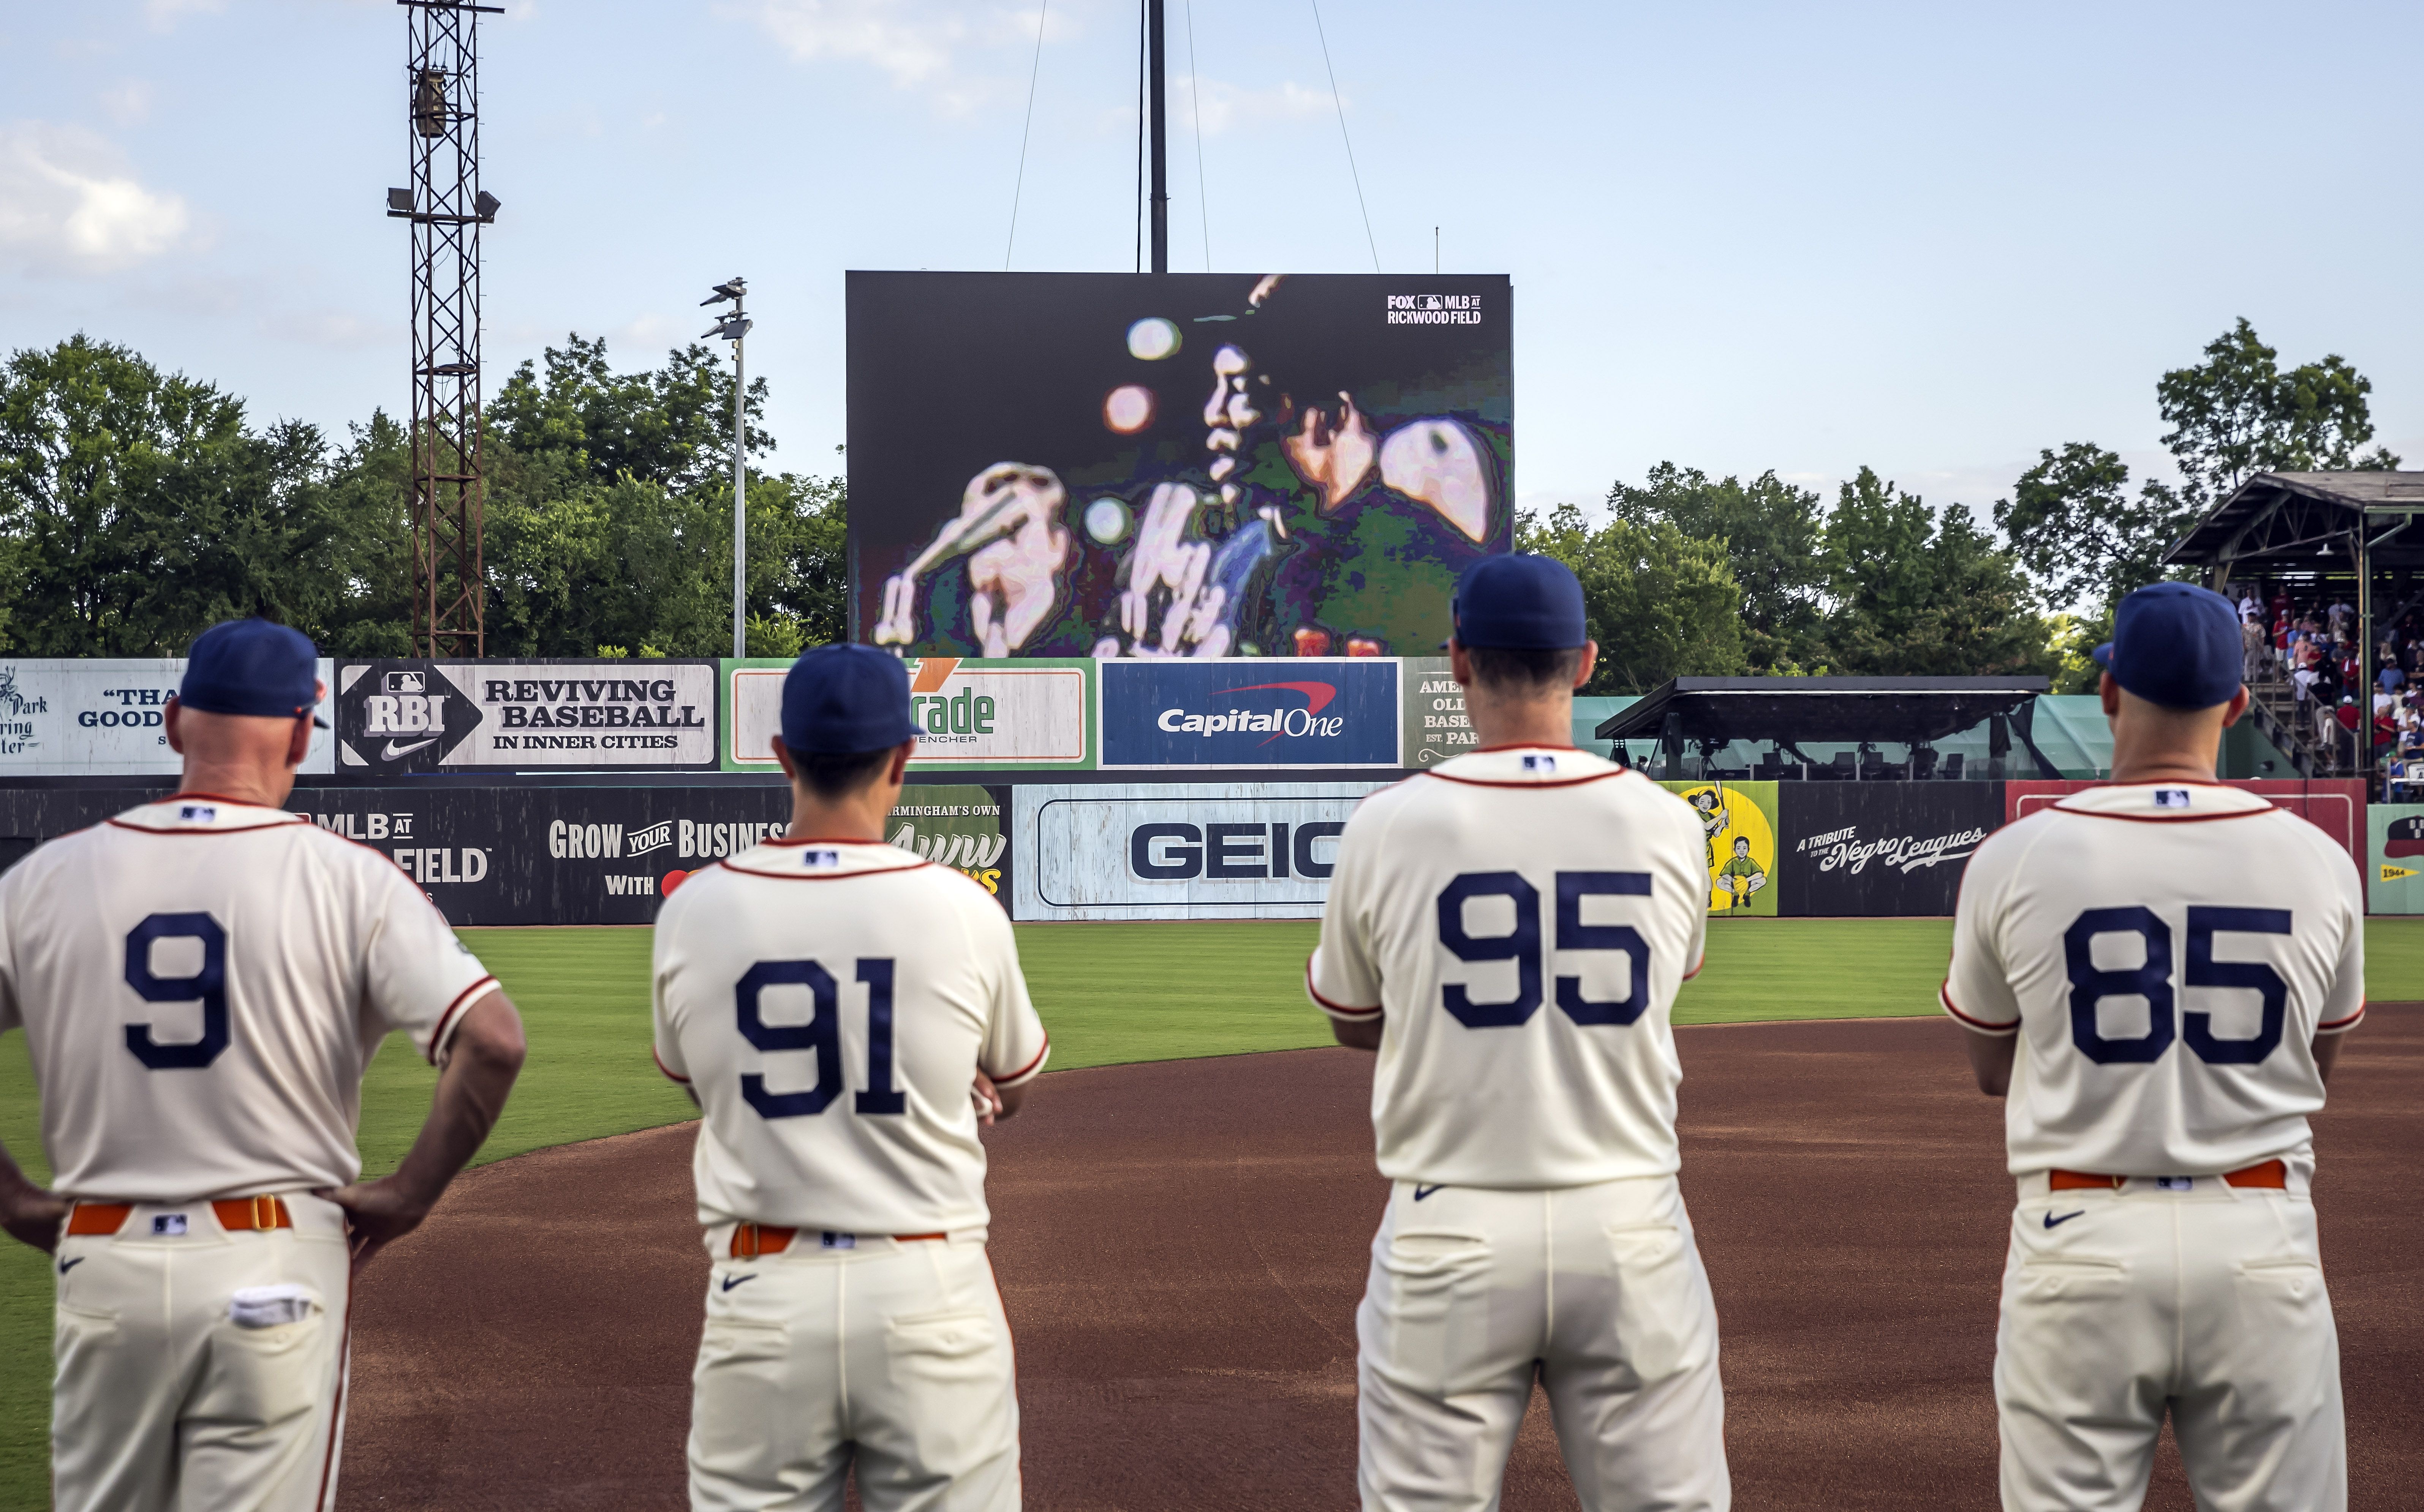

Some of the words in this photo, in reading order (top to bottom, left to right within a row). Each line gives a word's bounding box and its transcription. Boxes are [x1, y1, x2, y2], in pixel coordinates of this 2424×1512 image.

[1388, 295, 1416, 309] FOX
[1445, 295, 1470, 309] MLB
[1388, 311, 1449, 324] RICKWOOD
[1451, 311, 1481, 324] FIELD
[485, 680, 676, 702] REVIVING
[9, 693, 47, 716] Park
[368, 695, 445, 733] RBI
[78, 711, 163, 727] GOOD
[502, 706, 705, 728] BASEBALL
[1425, 715, 1474, 728] BASE
[493, 736, 518, 749] IN
[523, 735, 597, 749] INNER
[601, 735, 678, 749] CITIES
[973, 805, 1000, 815] OWN
[318, 814, 389, 839] MLB
[394, 819, 412, 833] AT
[629, 825, 671, 853] YOUR
[1796, 839, 1806, 852] A
[1809, 826, 1856, 849] TRIBUTE
[1820, 840, 1899, 875] Negro
[1885, 827, 1987, 868] Leagues
[394, 848, 487, 883] FIELD
[2383, 868, 2405, 878] 1944
[1437, 871, 1652, 1028] 95
[125, 911, 231, 1069] 9
[2063, 905, 2292, 1065] 85
[735, 957, 906, 1119] 91
